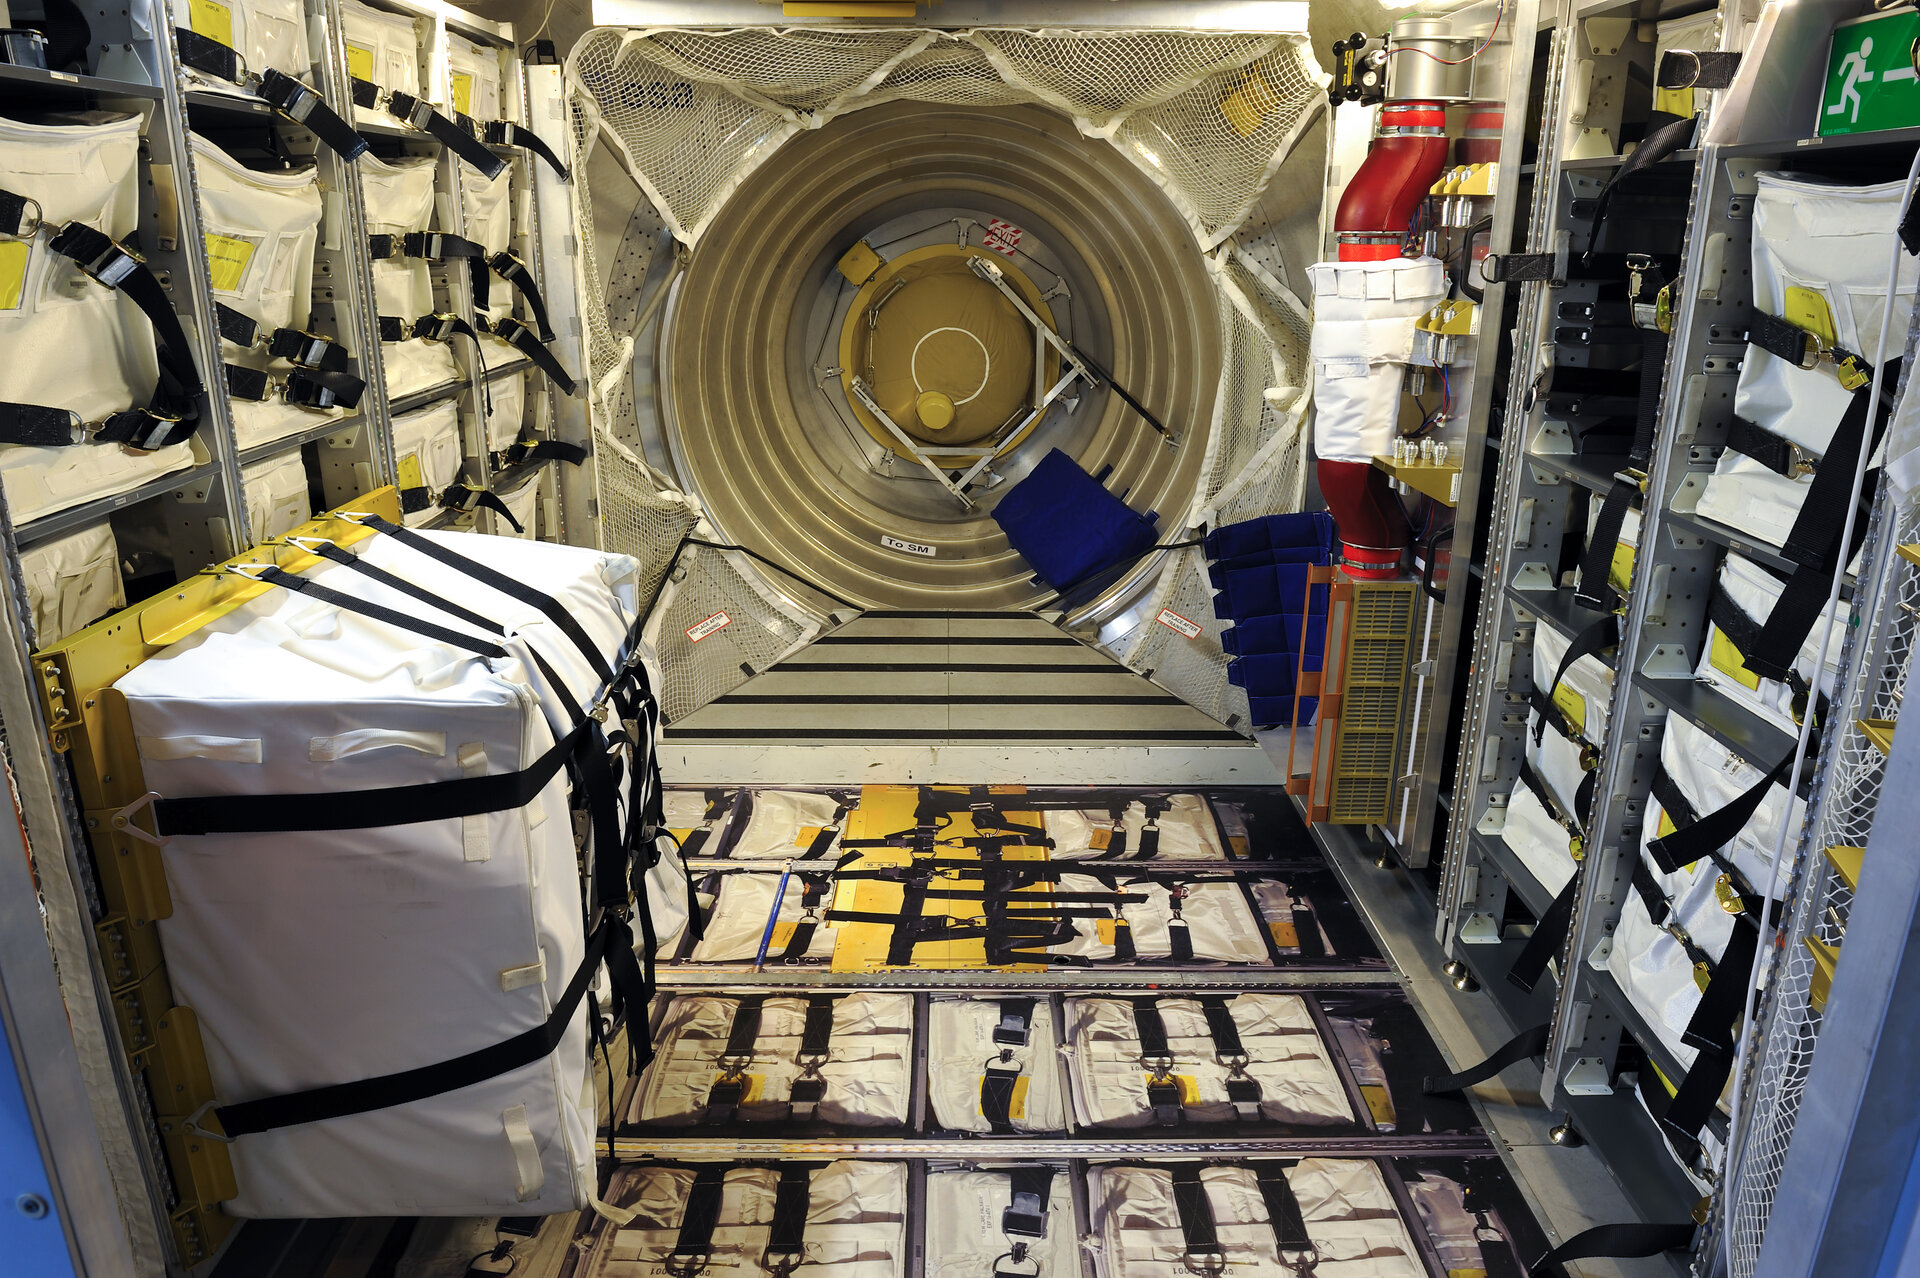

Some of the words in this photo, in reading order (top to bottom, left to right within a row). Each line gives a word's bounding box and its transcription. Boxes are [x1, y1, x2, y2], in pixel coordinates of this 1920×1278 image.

[990, 226, 1016, 247] EXIT
[887, 537, 903, 548] To
[908, 544, 929, 553] SM
[689, 621, 710, 635] REPLACE
[709, 613, 724, 624] AFTER
[700, 622, 721, 635] TRAINING
[1164, 611, 1185, 625] REPLACE
[1183, 621, 1198, 632] AFTER
[1167, 619, 1187, 633] TRAINING
